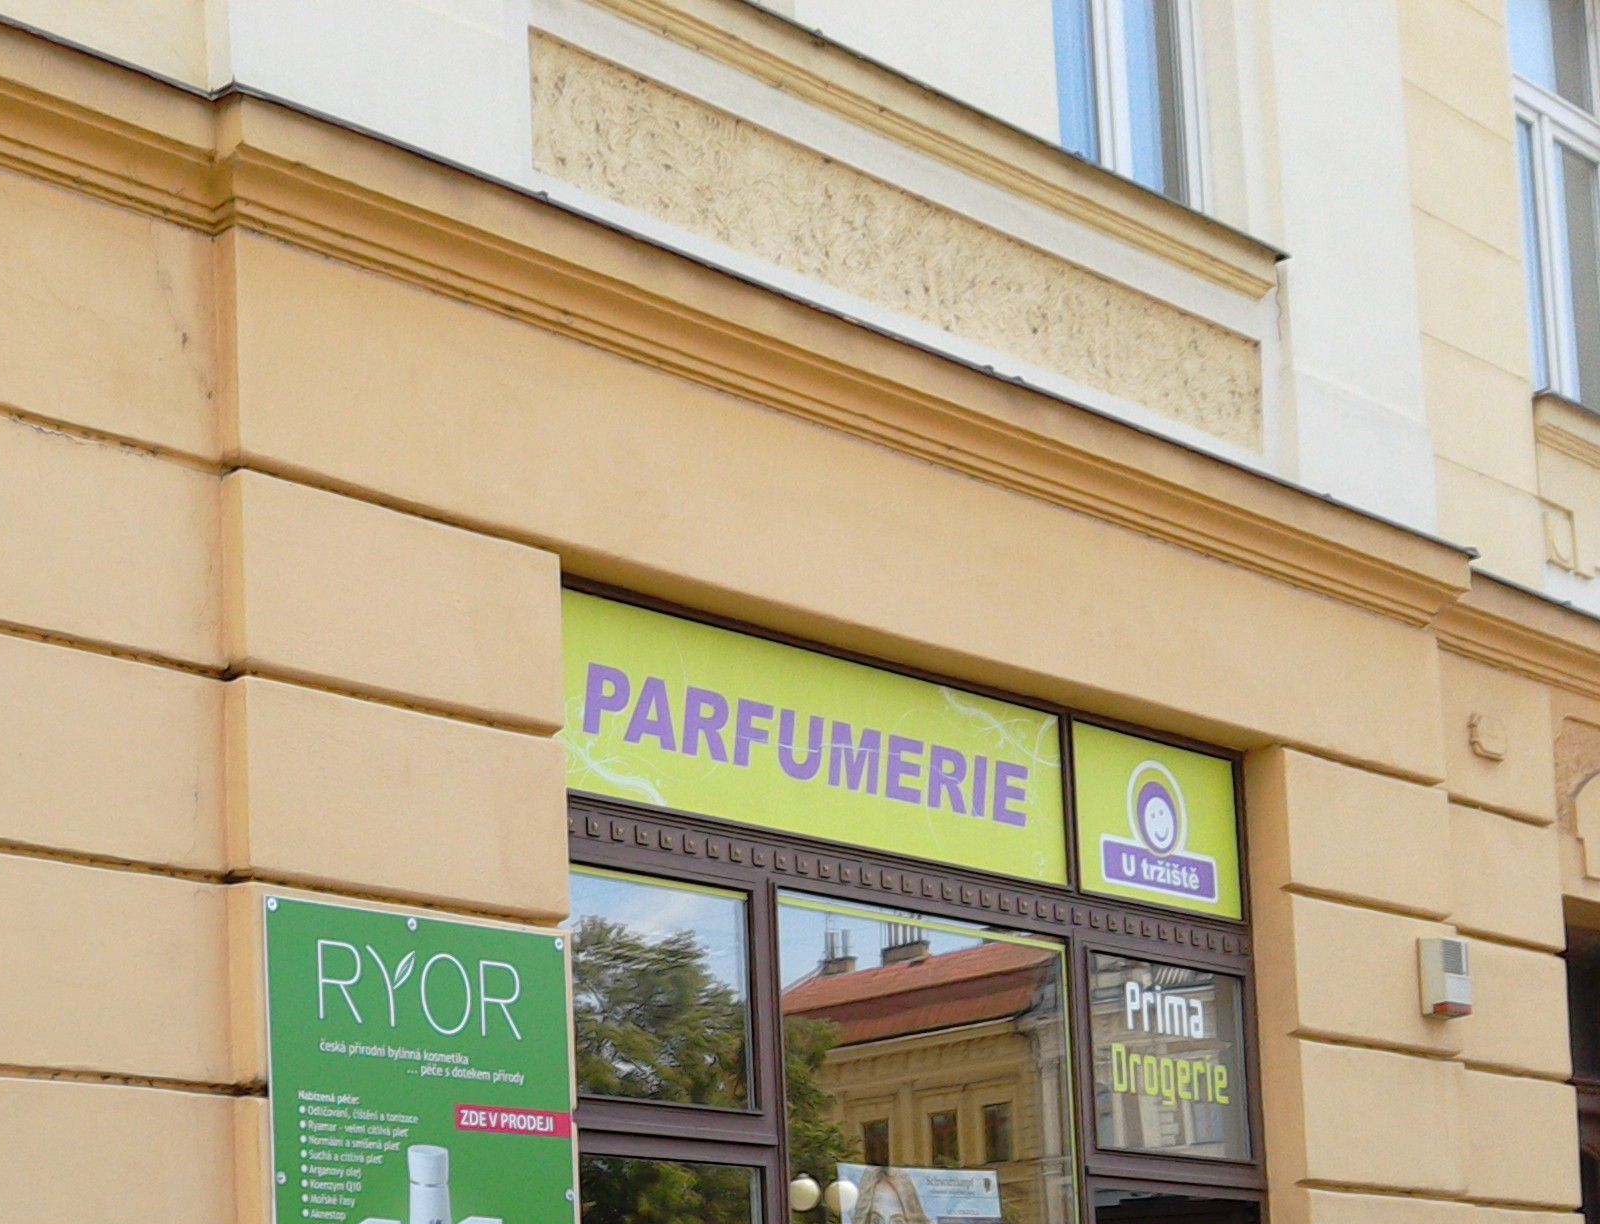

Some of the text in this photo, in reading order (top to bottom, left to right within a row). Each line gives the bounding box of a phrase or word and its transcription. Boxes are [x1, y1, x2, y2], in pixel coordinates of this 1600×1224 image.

[582, 661, 1029, 829] PARFUMERIE
[1121, 853, 1201, 891] U tržiště
[317, 938, 523, 1041] RYOR
[1125, 981, 1205, 1039] Prima
[319, 1038, 347, 1053] česká
[349, 1041, 386, 1057] přírodní
[423, 1049, 469, 1065] kosmetika
[1111, 1042, 1230, 1107] Drogerie
[451, 1066, 491, 1081] dotekem
[493, 1070, 525, 1086] přírody
[460, 1109, 554, 1132] ZDE V PRODEJI
